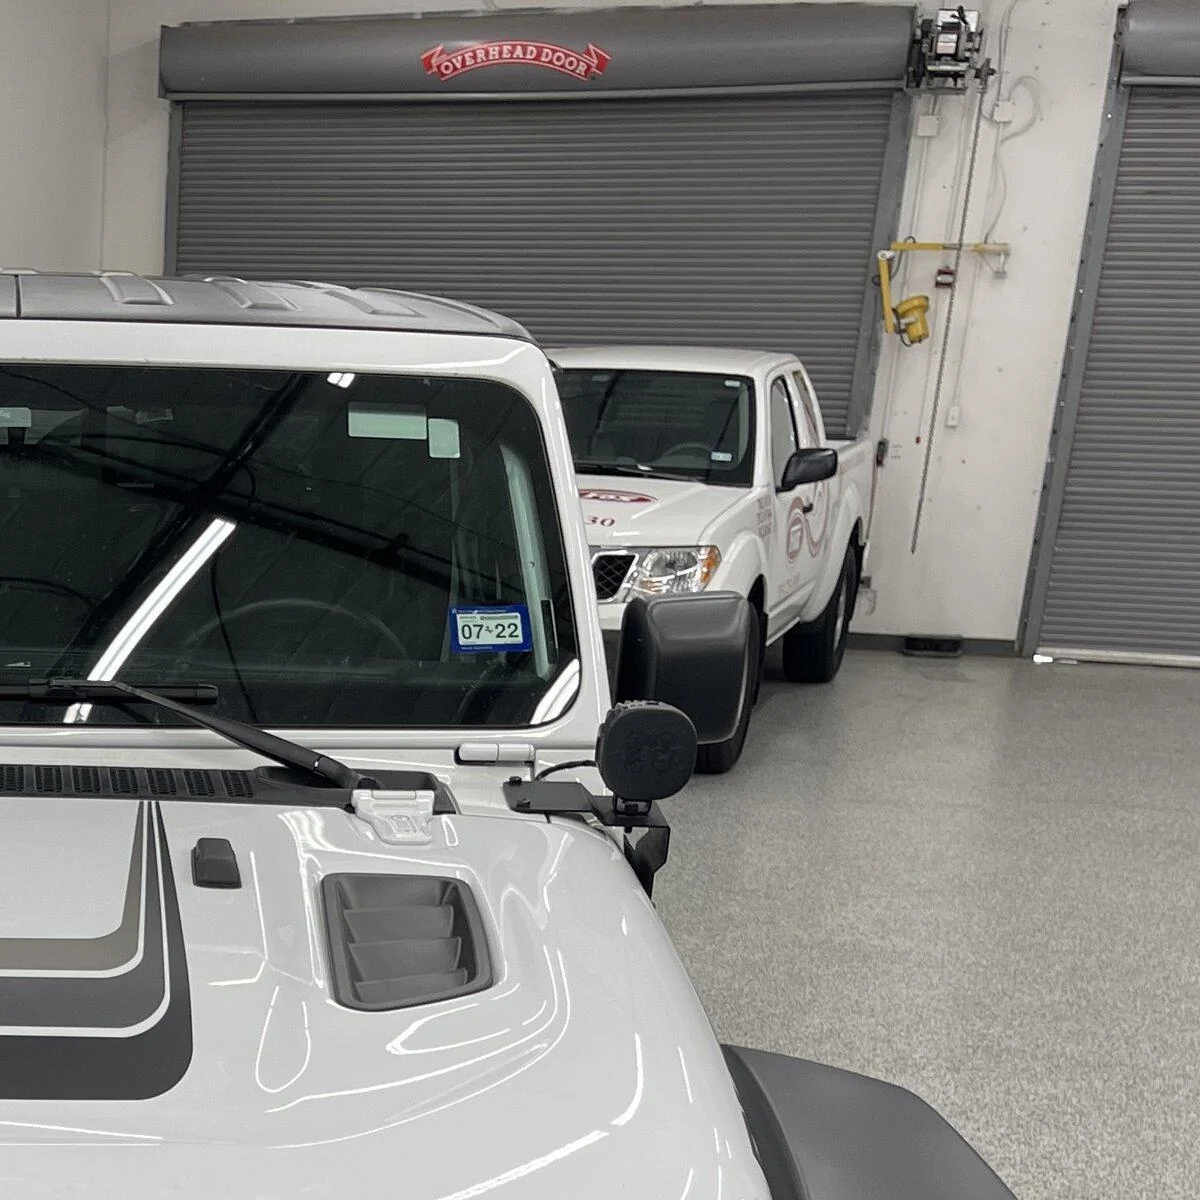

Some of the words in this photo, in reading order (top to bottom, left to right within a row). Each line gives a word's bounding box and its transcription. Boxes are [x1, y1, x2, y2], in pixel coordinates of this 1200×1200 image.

[440, 45, 538, 75] OVERHEAD
[540, 49, 588, 75] DOOR
[461, 623, 484, 640] 07
[494, 622, 519, 639] 22
